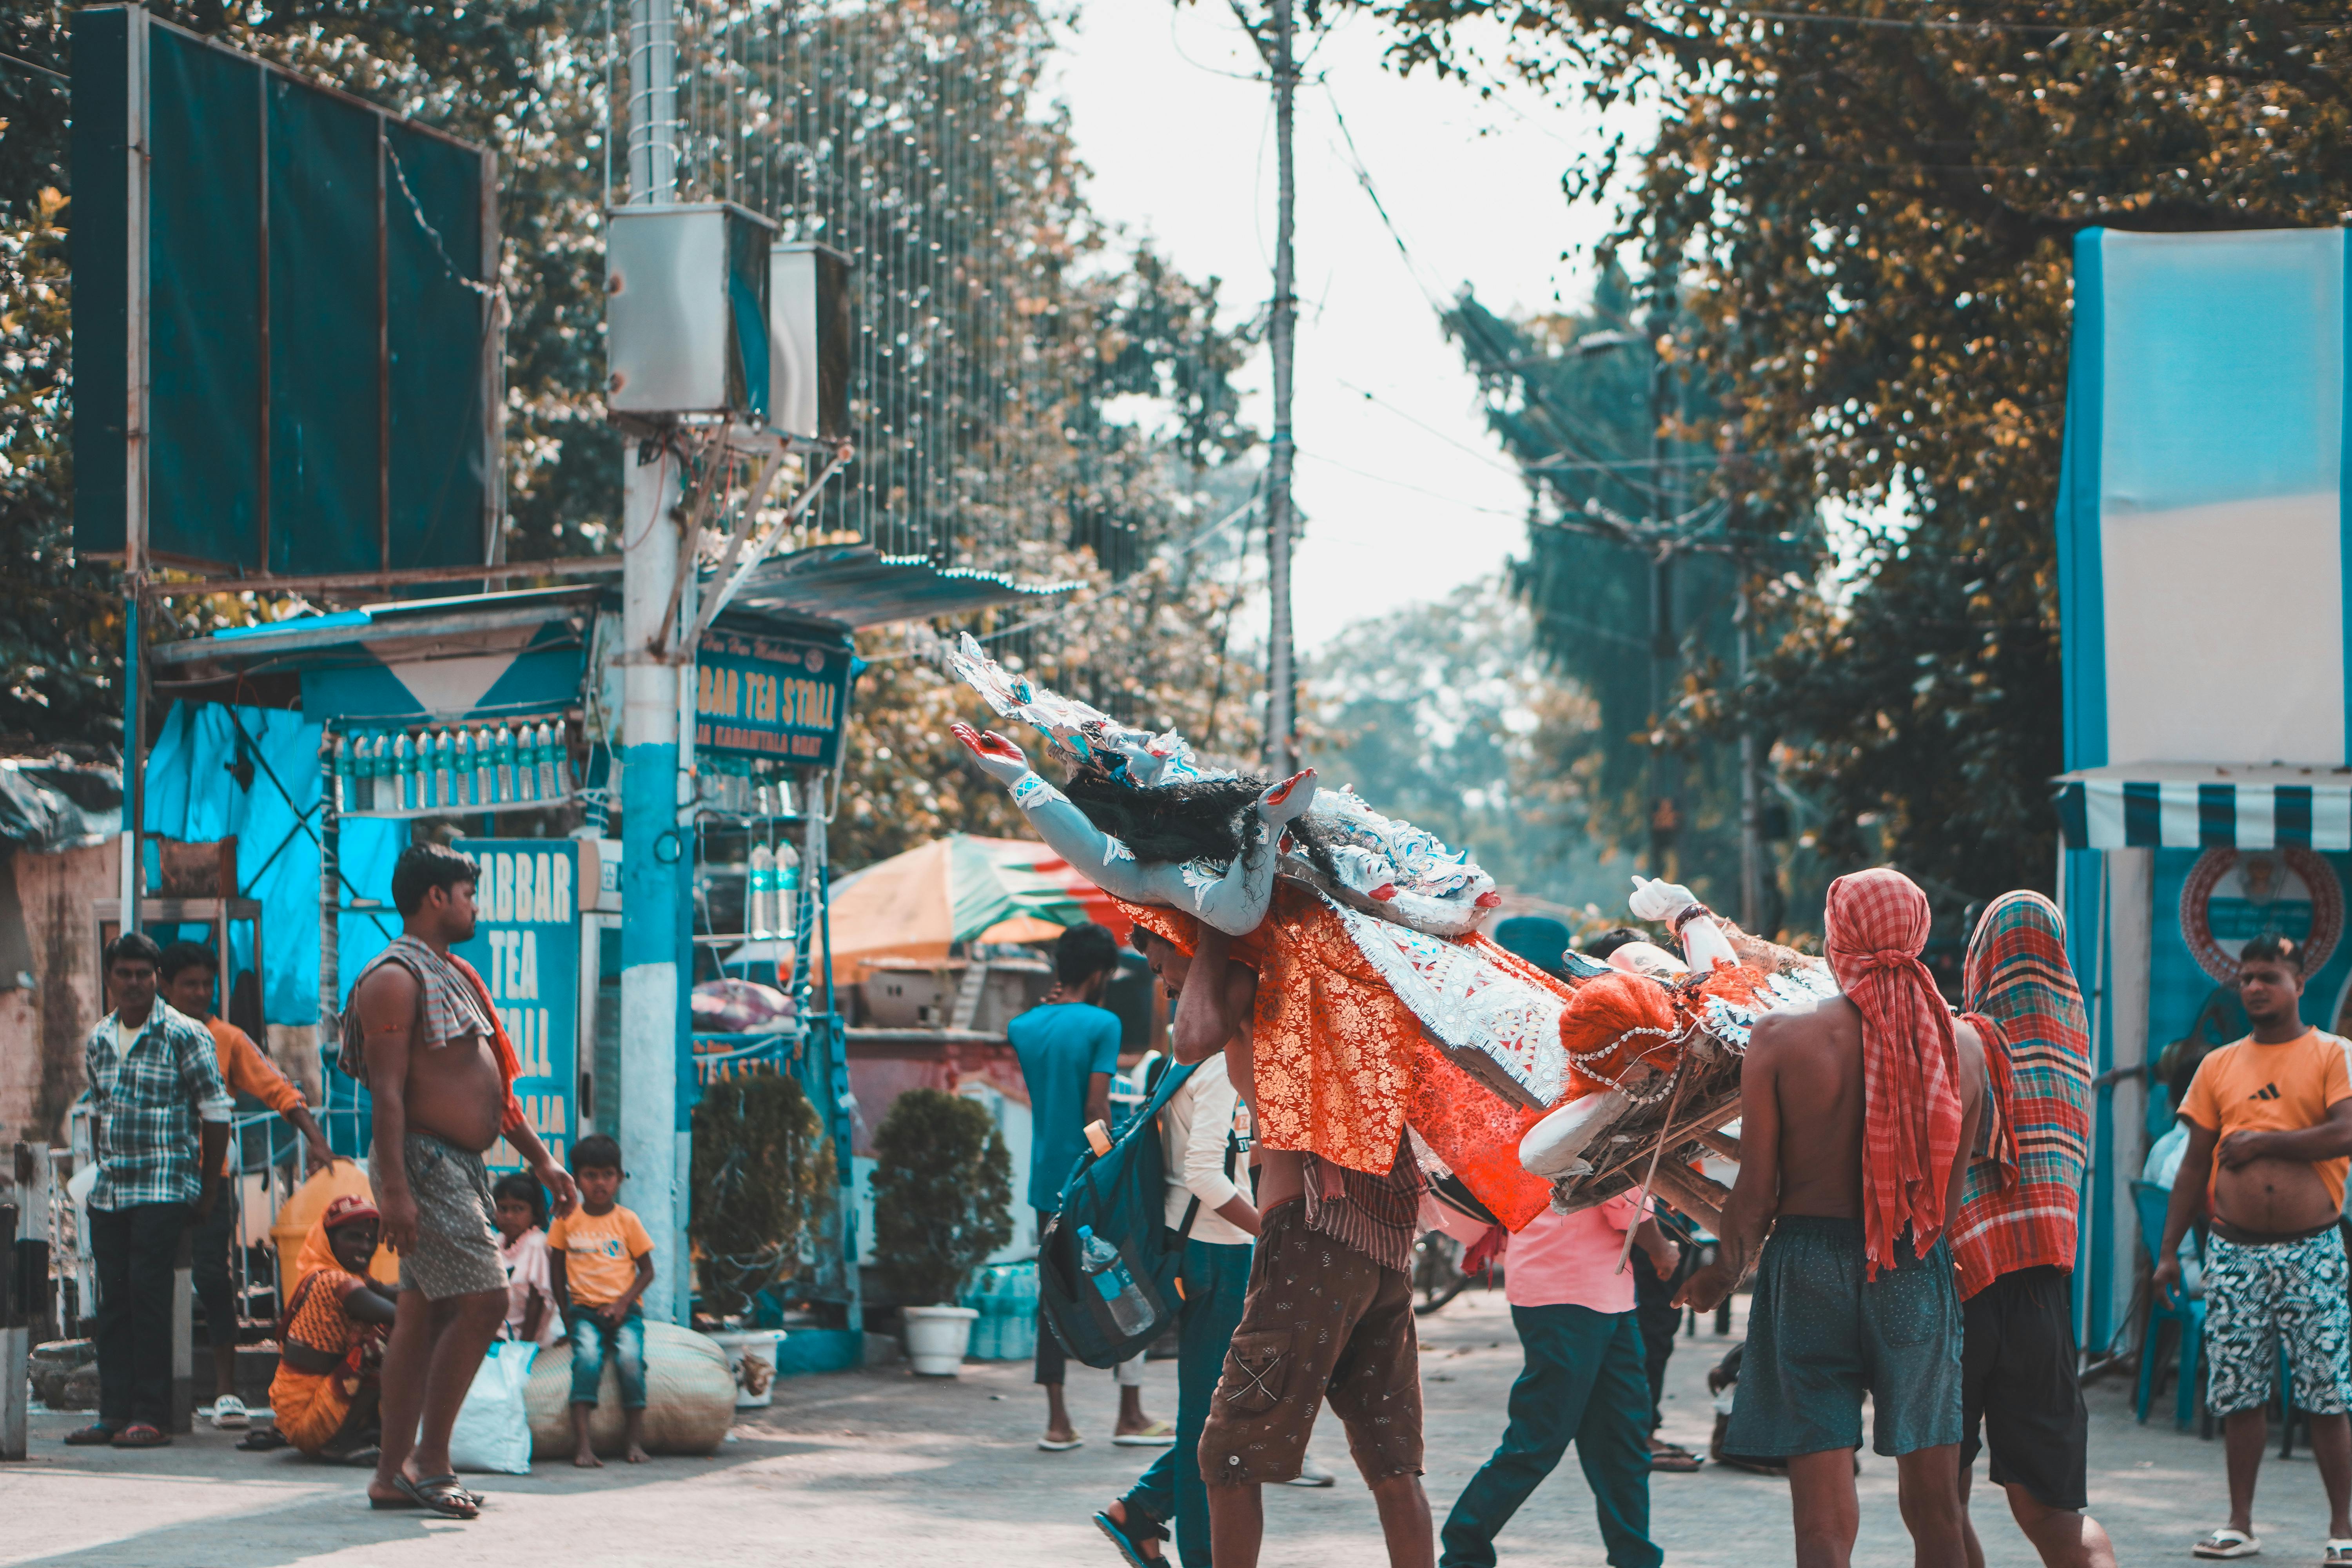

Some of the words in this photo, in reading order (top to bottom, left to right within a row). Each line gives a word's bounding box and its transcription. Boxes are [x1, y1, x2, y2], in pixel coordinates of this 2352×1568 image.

[697, 665, 739, 717] BAR
[745, 671, 777, 722] TEA
[782, 677, 835, 731] STALL
[463, 851, 571, 923] ABBAR
[488, 930, 539, 1000] TEA
[513, 1095, 566, 1134] AJA
